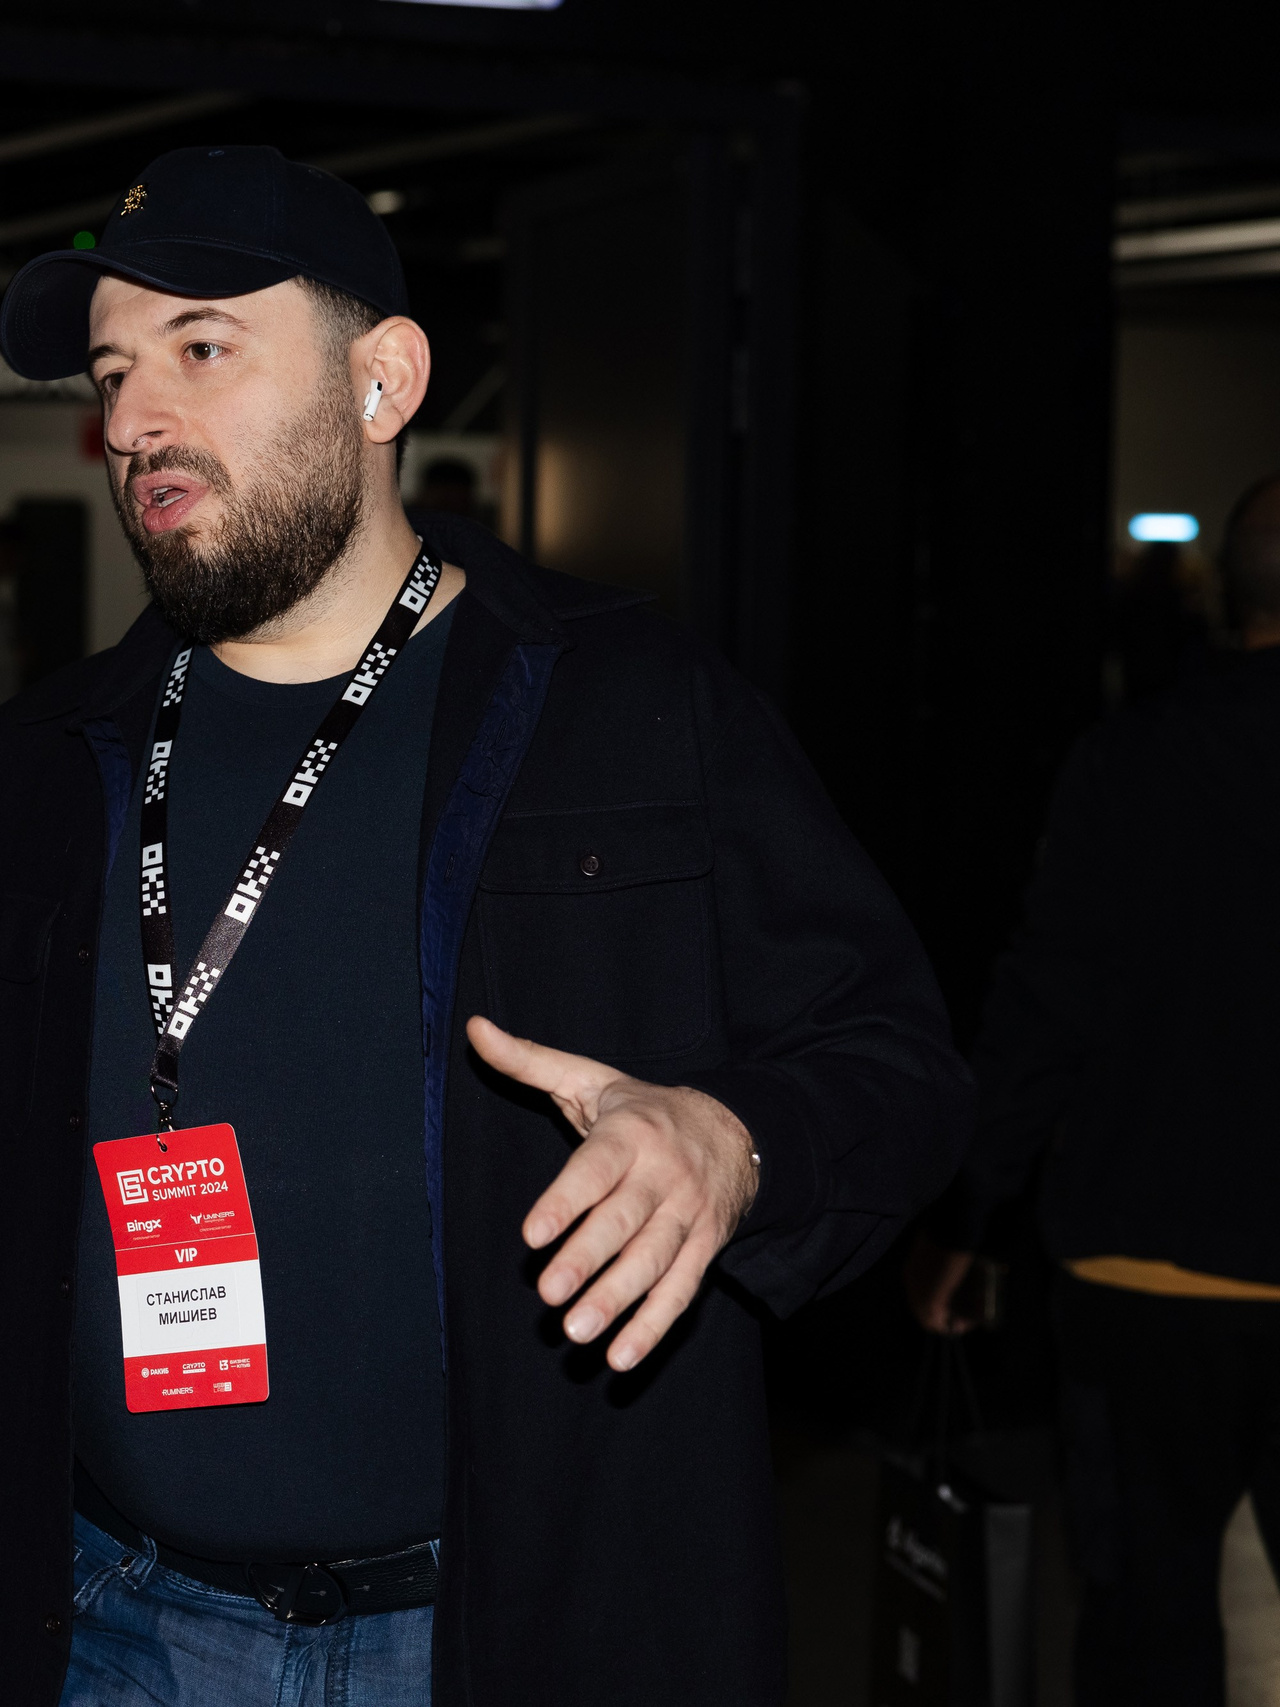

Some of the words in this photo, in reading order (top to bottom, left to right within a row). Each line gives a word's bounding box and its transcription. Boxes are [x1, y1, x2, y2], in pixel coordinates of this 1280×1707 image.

[398, 555, 440, 614] OKX
[163, 648, 193, 707] OKX
[342, 642, 397, 705] OKX
[144, 740, 173, 804] OKX
[282, 739, 338, 807] OKX
[142, 842, 167, 916] OKX
[224, 846, 280, 924] OKX
[167, 961, 220, 1040] OKX
[147, 1158, 225, 1185] CRYPTO
[152, 1184, 197, 1201] SUMMIT
[200, 1180, 229, 1195] 2024
[175, 1247, 198, 1263] VIP
[146, 1285, 227, 1306] СТАНИСЛАВ
[159, 1307, 217, 1325] МИШИЕВ
[182, 1362, 205, 1370] CRYPTO
